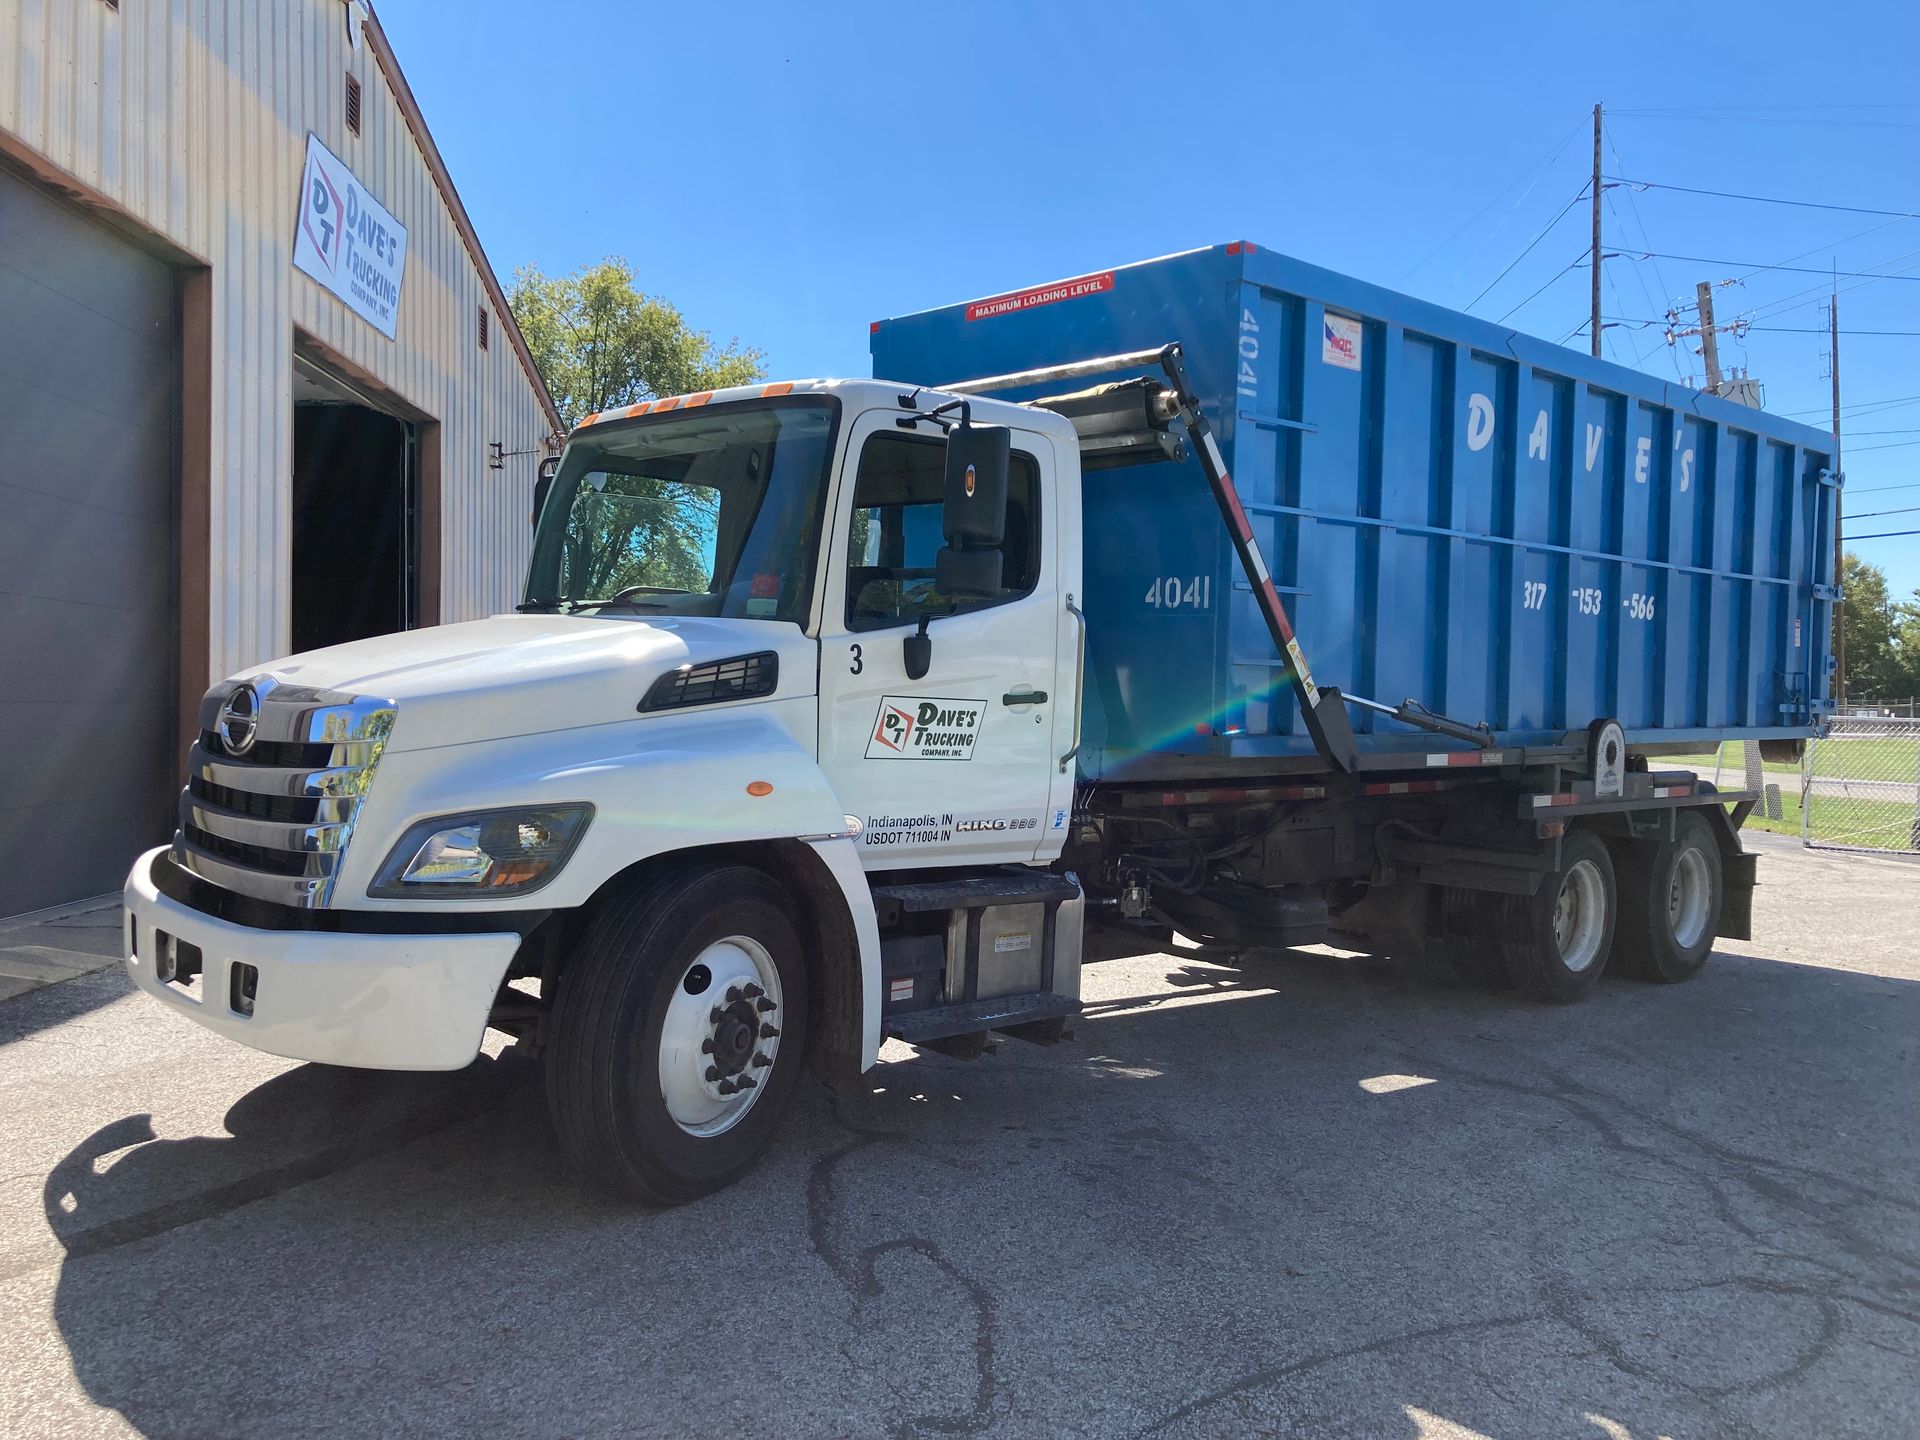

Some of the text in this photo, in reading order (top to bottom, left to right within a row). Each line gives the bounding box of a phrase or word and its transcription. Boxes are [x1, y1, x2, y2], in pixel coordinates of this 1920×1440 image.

[313, 178, 329, 214] D
[320, 218, 334, 254] T
[346, 183, 397, 268] DAVE'S
[345, 230, 397, 308] TRUCKING
[975, 280, 1103, 318] MAXIMUM LOADING LEVEL
[1237, 308, 1259, 397] 4041
[1145, 575, 1210, 609] 4041
[1524, 581, 1547, 610] 317
[850, 643, 863, 675] 3
[885, 714, 900, 729] D
[917, 702, 977, 728] DAVE'S
[893, 728, 905, 744] T
[914, 727, 974, 747] TRUCKING
[922, 748, 950, 757] COMPANY,
[868, 814, 953, 829] Indianapolis, IN
[956, 819, 1007, 832] HINO
[866, 830, 951, 845] USDOT 711004 IN
